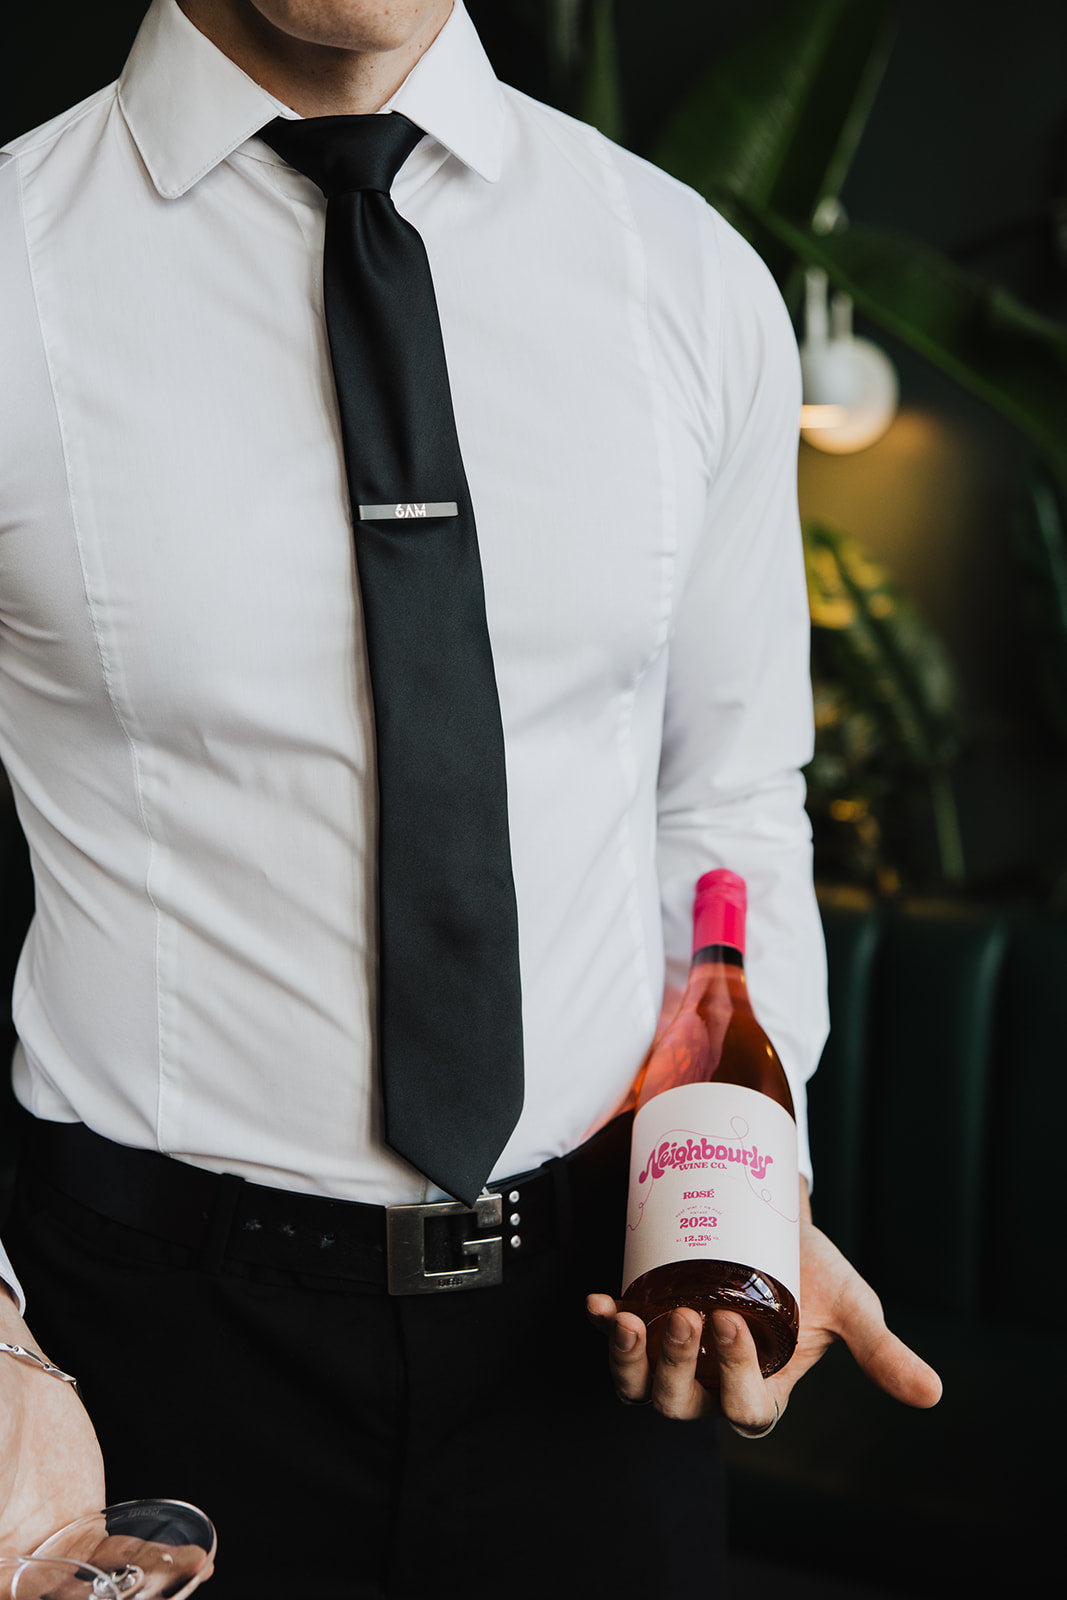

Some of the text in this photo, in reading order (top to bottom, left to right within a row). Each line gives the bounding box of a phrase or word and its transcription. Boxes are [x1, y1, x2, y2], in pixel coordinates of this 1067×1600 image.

[395, 503, 426, 518] 6AM
[639, 1138, 773, 1184] Neighbourly
[679, 1162, 728, 1171] WINE CO.
[683, 1189, 715, 1199] ROSÉ
[680, 1216, 717, 1229] 2023
